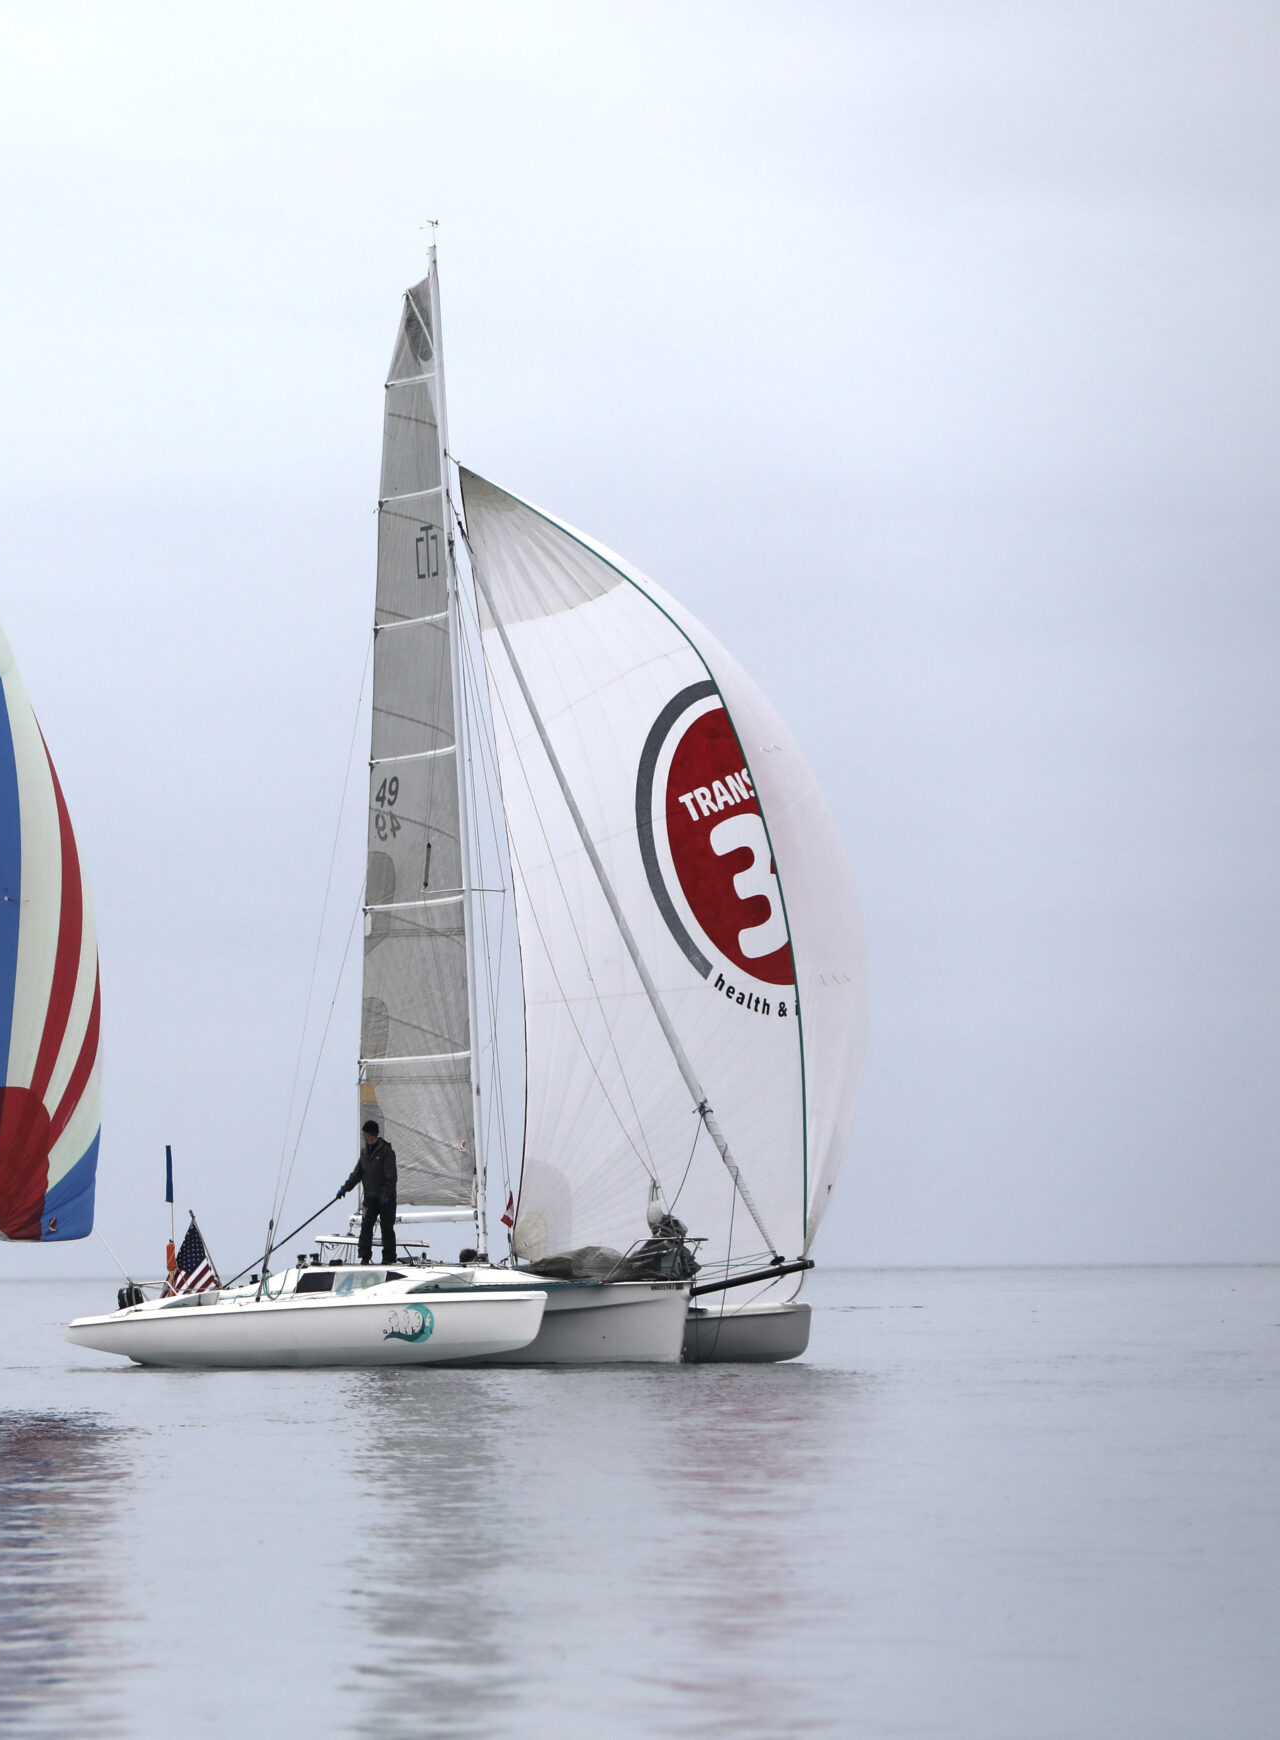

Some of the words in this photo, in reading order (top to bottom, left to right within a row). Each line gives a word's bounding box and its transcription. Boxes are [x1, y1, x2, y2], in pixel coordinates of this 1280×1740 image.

[375, 776, 400, 809] 49
[709, 812, 790, 959] 3
[714, 973, 771, 1016] health
[778, 1001, 788, 1017] &
